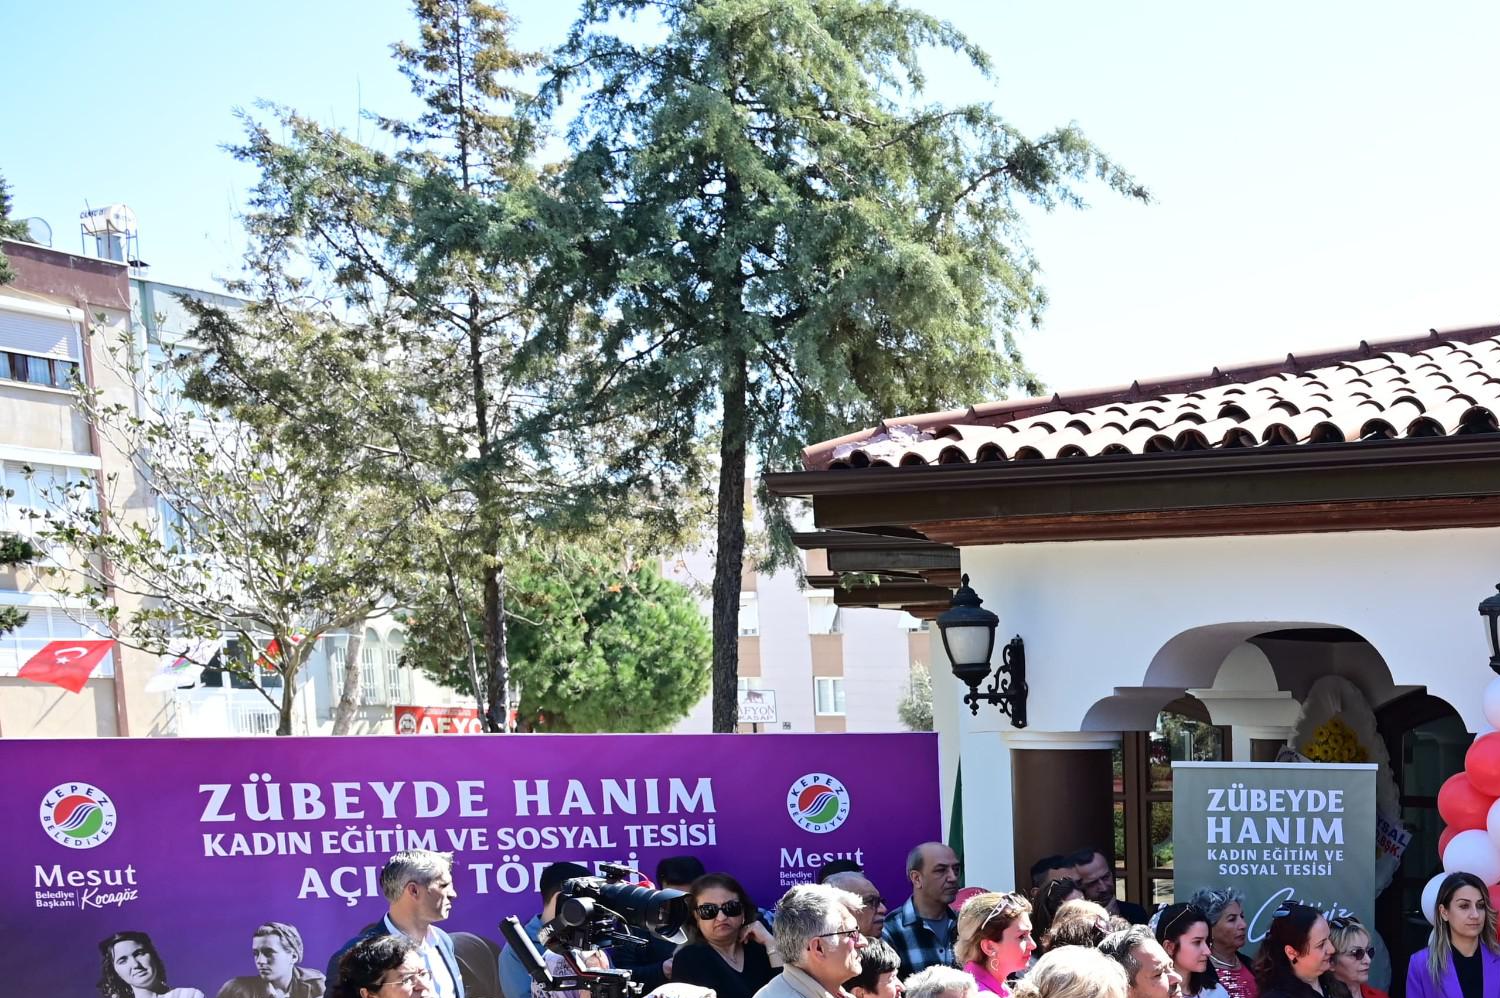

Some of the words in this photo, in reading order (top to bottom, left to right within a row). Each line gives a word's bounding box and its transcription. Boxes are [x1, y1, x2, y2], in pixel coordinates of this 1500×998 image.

[44, 784, 109, 809] KEPEZ
[198, 772, 489, 822] ZÜBEYDE
[512, 777, 717, 817] HANIM
[791, 775, 844, 797] KEPEZ
[1206, 782, 1345, 813] ZÜBEYDE
[202, 831, 313, 857] KADIN
[320, 823, 439, 854] EĞİTİM
[445, 827, 490, 851] VE
[496, 825, 617, 850] SOSYAL
[623, 818, 718, 848] TESİSİ
[1206, 816, 1345, 845] HANIM
[1207, 849, 1257, 861] KADIN
[1262, 847, 1318, 861] EĞİTİM
[1324, 850, 1344, 862] VE
[34, 863, 137, 888] Mesut
[1218, 863, 1278, 876] SOSYAL
[1284, 862, 1333, 876] TESİSİ
[35, 890, 75, 901] Belediye
[81, 887, 139, 910] Kocagöz
[297, 865, 385, 907] AÇI
[36, 899, 75, 909] Başkanı
